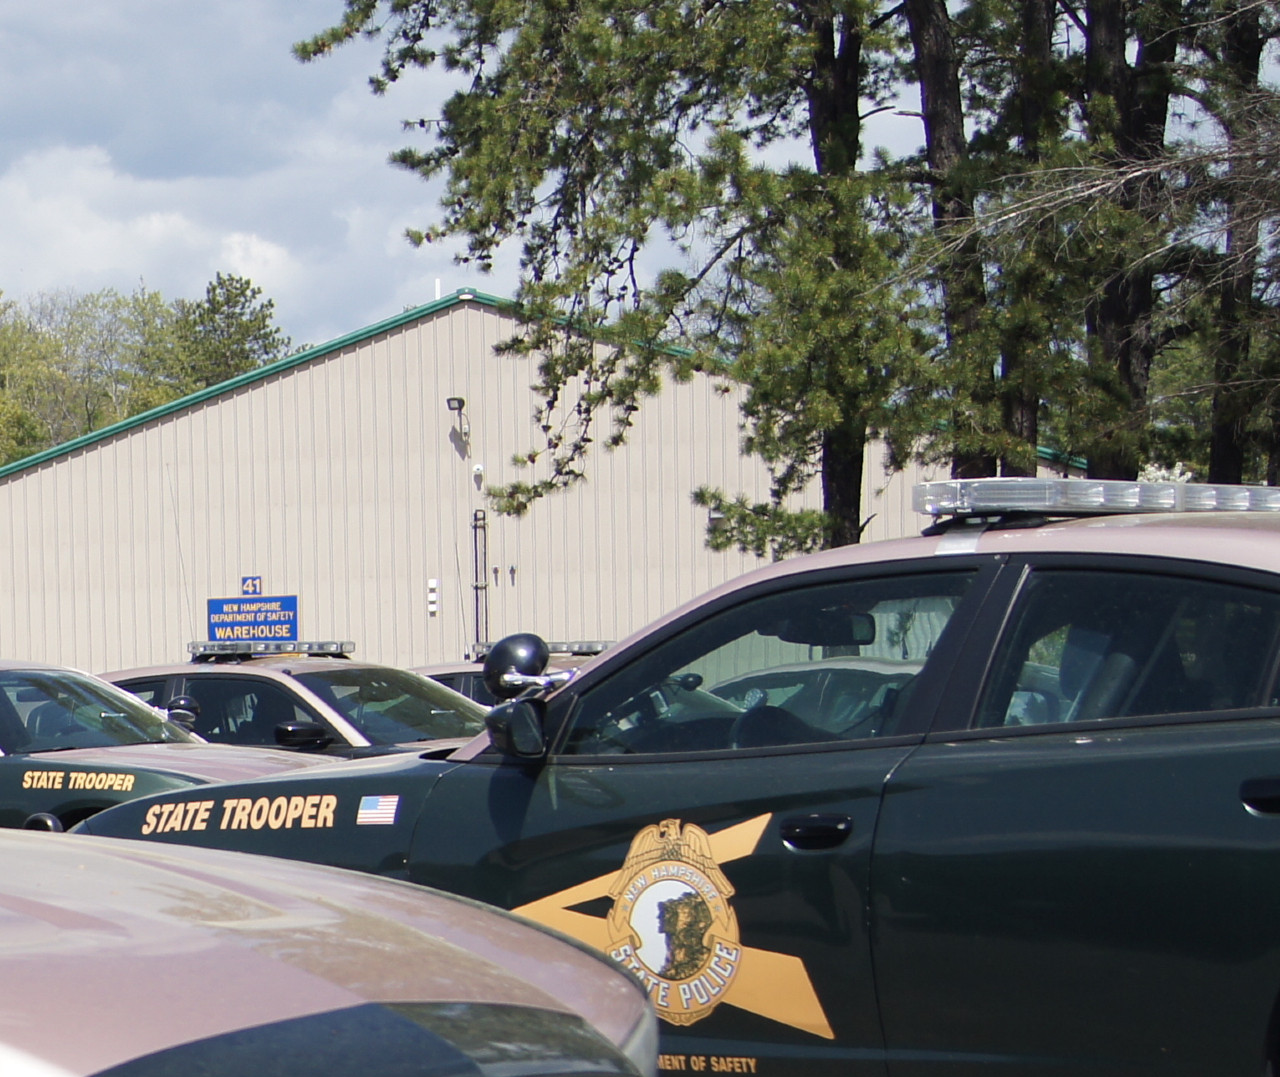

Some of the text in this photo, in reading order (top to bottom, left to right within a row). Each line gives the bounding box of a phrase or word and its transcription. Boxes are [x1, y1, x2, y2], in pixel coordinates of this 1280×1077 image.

[243, 578, 261, 593] 41
[223, 602, 281, 613] NEW HAMPSHIRE
[211, 611, 294, 623] DEPARTMENT OF SAFETY
[215, 625, 291, 639] WAREHOUSE
[22, 770, 135, 792] STATE TROOPER
[141, 794, 338, 835] STATE TROOPER
[623, 865, 719, 902] NEW HAMPSHIRE
[678, 942, 740, 1009] POLICE
[690, 1055, 706, 1071] OF
[710, 1056, 757, 1073] SAFETY
